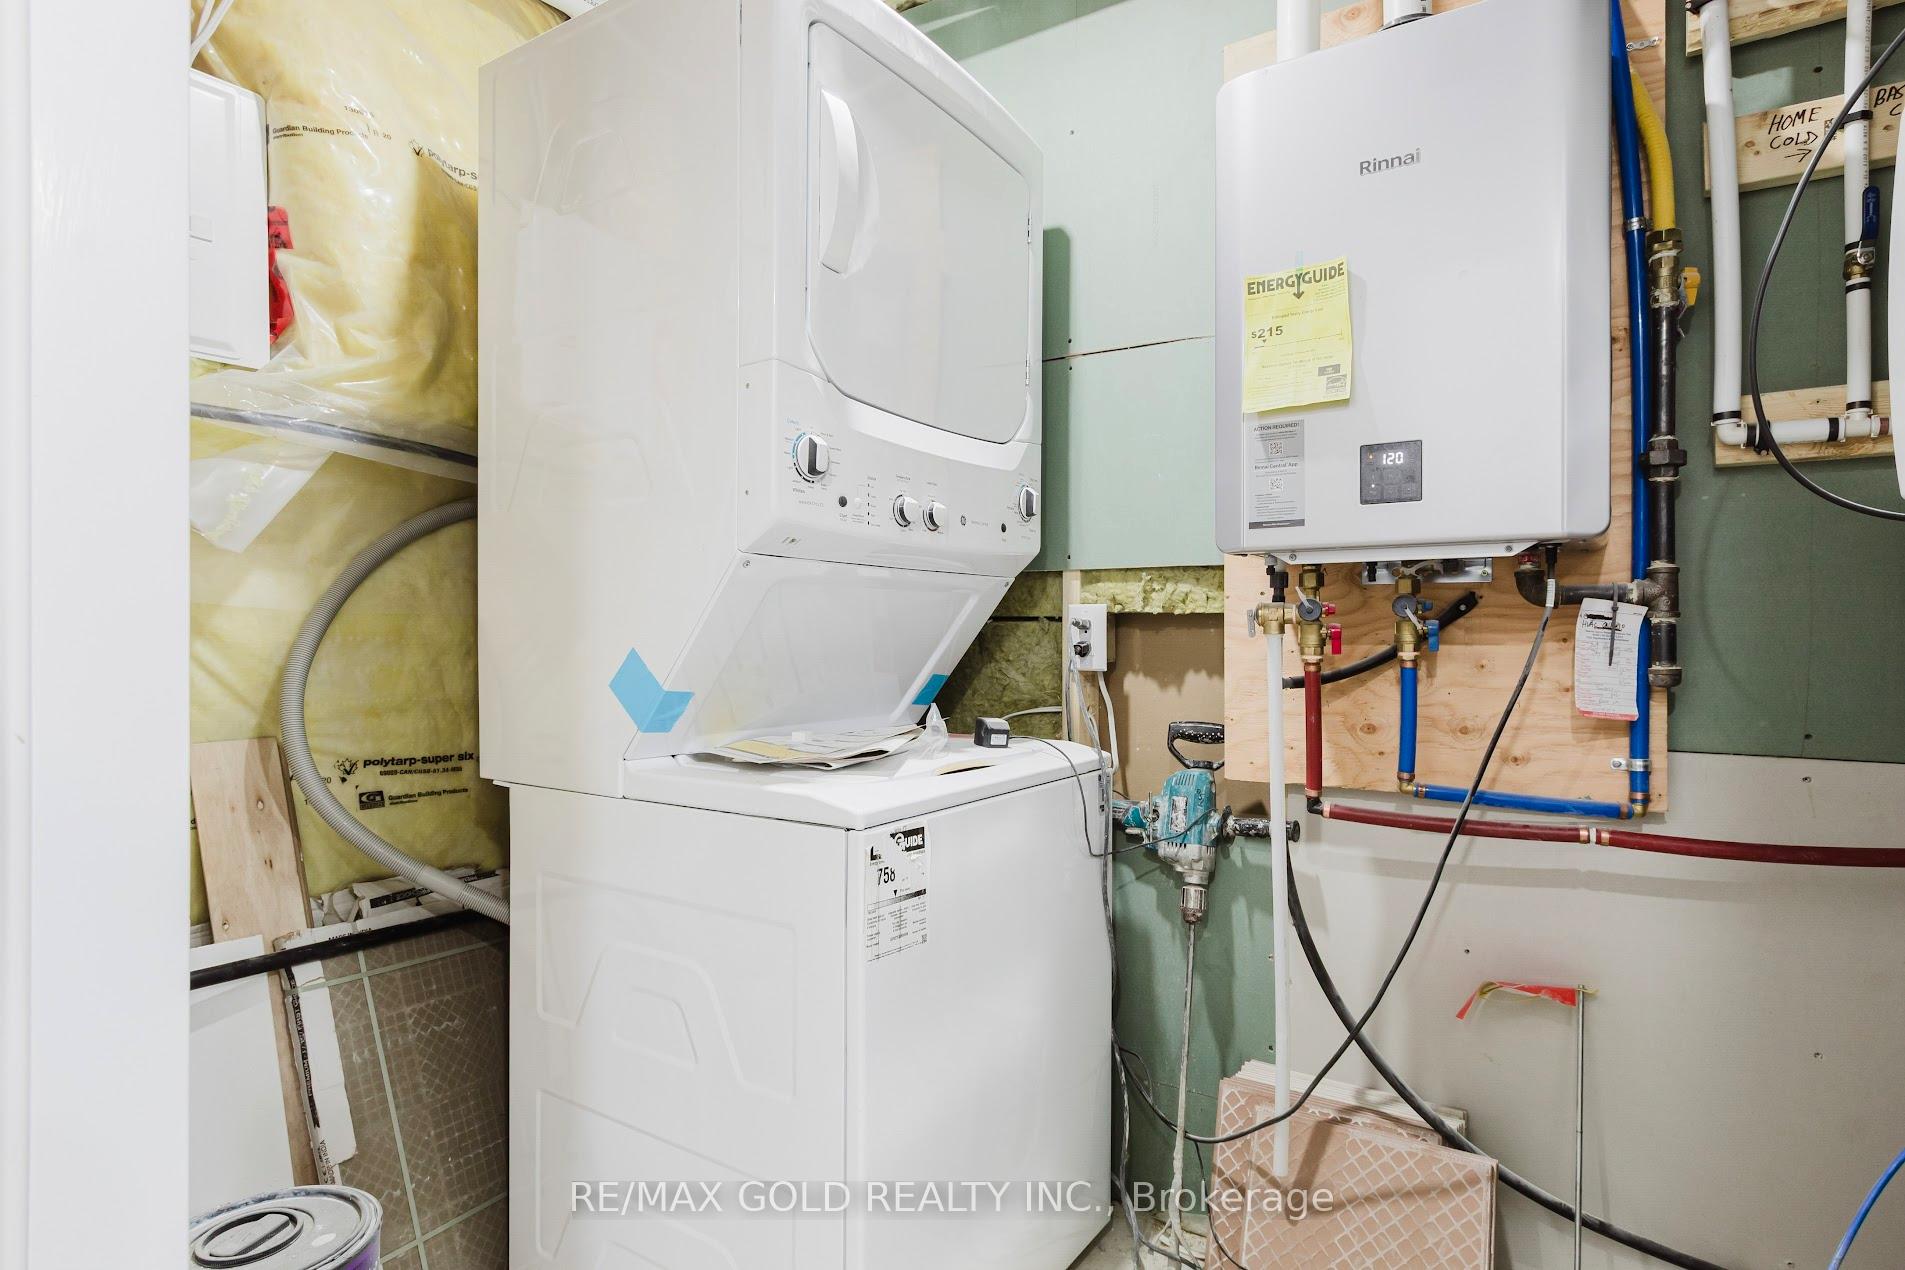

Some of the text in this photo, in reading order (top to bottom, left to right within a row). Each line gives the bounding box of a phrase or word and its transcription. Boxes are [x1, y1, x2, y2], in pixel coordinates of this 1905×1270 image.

[1768, 106, 1822, 135] HOME
[302, 125, 335, 136] Building
[1769, 131, 1819, 150] COLD
[1359, 147, 1421, 176] Rinnai
[1247, 261, 1345, 299] ENERGYGUIDE
[1251, 325, 1284, 339] $215
[1382, 451, 1404, 465] 120
[363, 751, 475, 769] polytarp-super six
